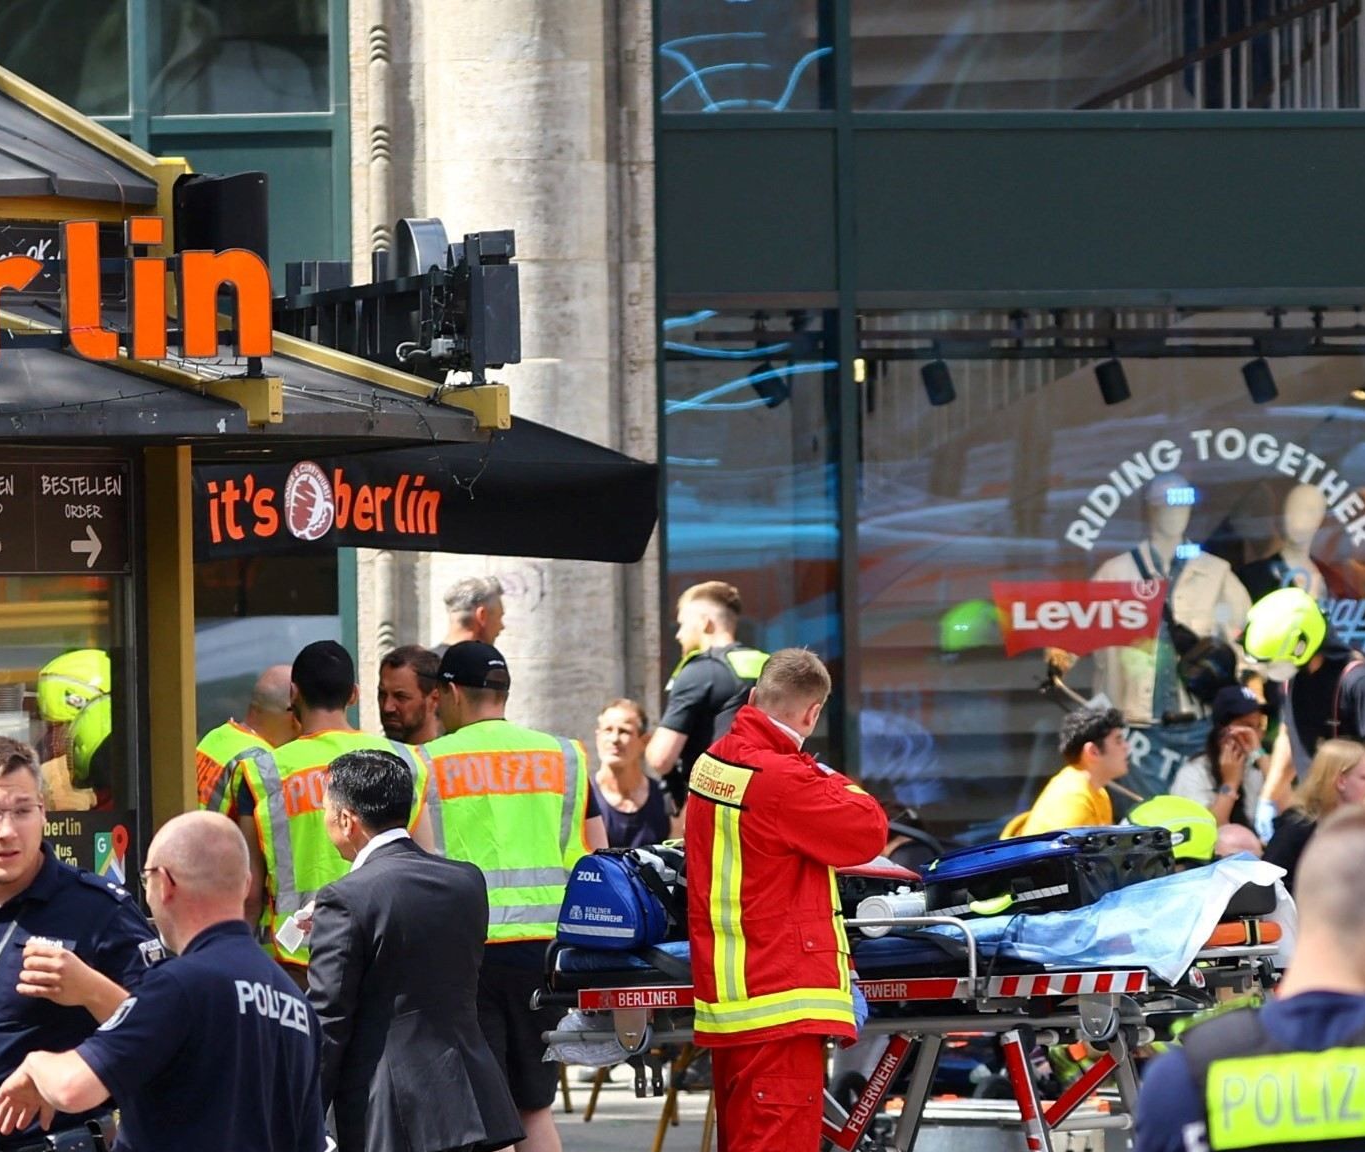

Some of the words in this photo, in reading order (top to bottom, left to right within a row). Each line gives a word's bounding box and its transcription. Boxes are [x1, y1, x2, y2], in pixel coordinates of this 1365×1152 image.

[41, 474, 122, 497] BESTELLEN
[1066, 438, 1182, 551] RIDING
[65, 503, 103, 519] ORDER
[207, 474, 280, 543] it's
[334, 468, 441, 534] berlin
[445, 753, 559, 796] POLIZEI
[577, 871, 602, 883] ZOLL
[585, 914, 623, 923] FEUERWEHR
[618, 990, 677, 1007] BERLINER
[861, 983, 907, 999] ERWEHR
[847, 1052, 899, 1133] FEUERWEHR
